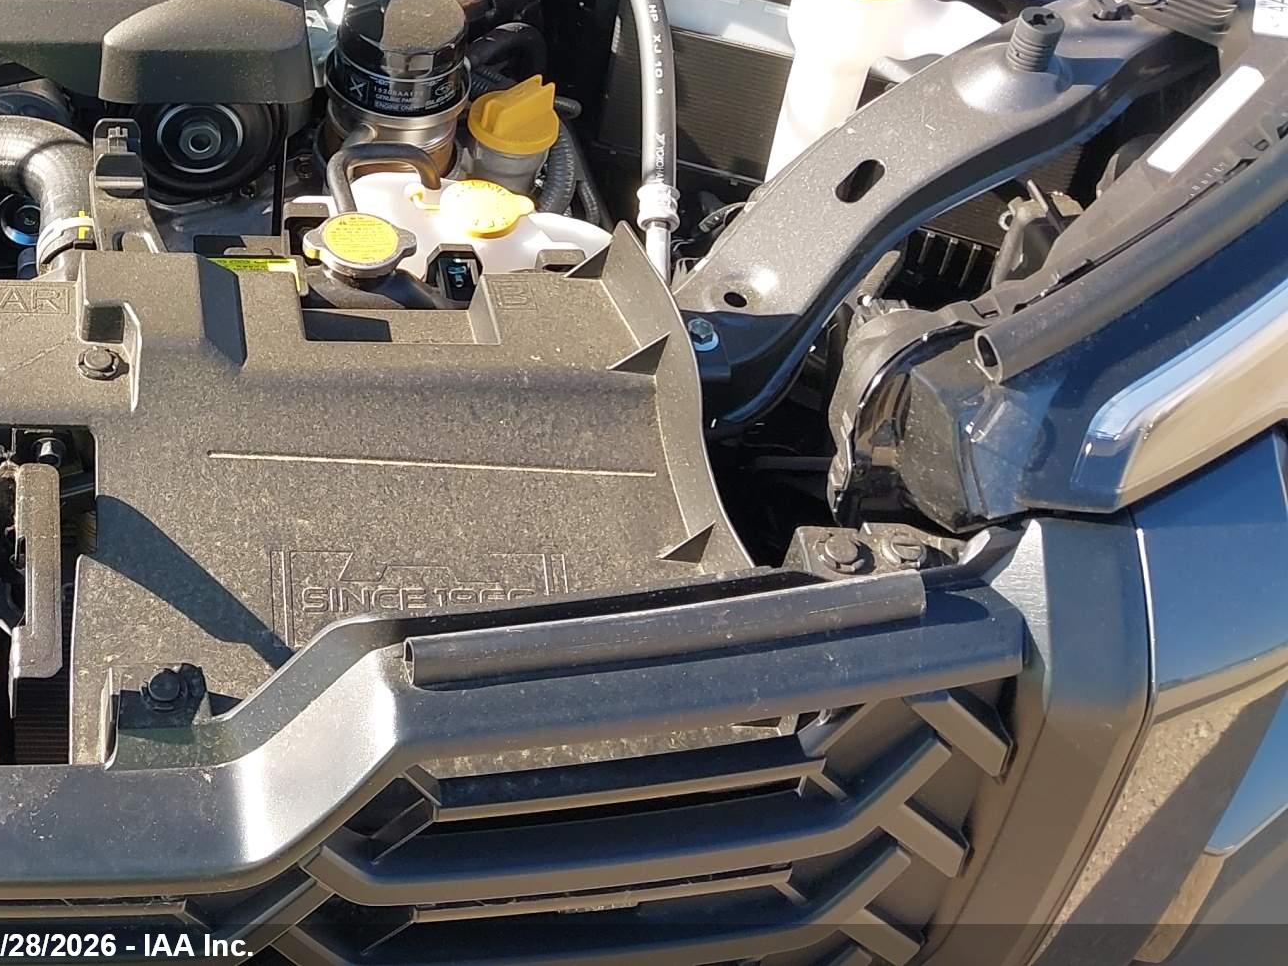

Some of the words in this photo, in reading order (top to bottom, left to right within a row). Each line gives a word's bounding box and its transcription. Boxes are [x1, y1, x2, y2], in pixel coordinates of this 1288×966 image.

[648, 4, 660, 23] HP
[652, 33, 662, 54] XJ
[655, 146, 665, 185] YOKOHAM
[0, 287, 63, 312] AR
[302, 586, 428, 613] SINCE
